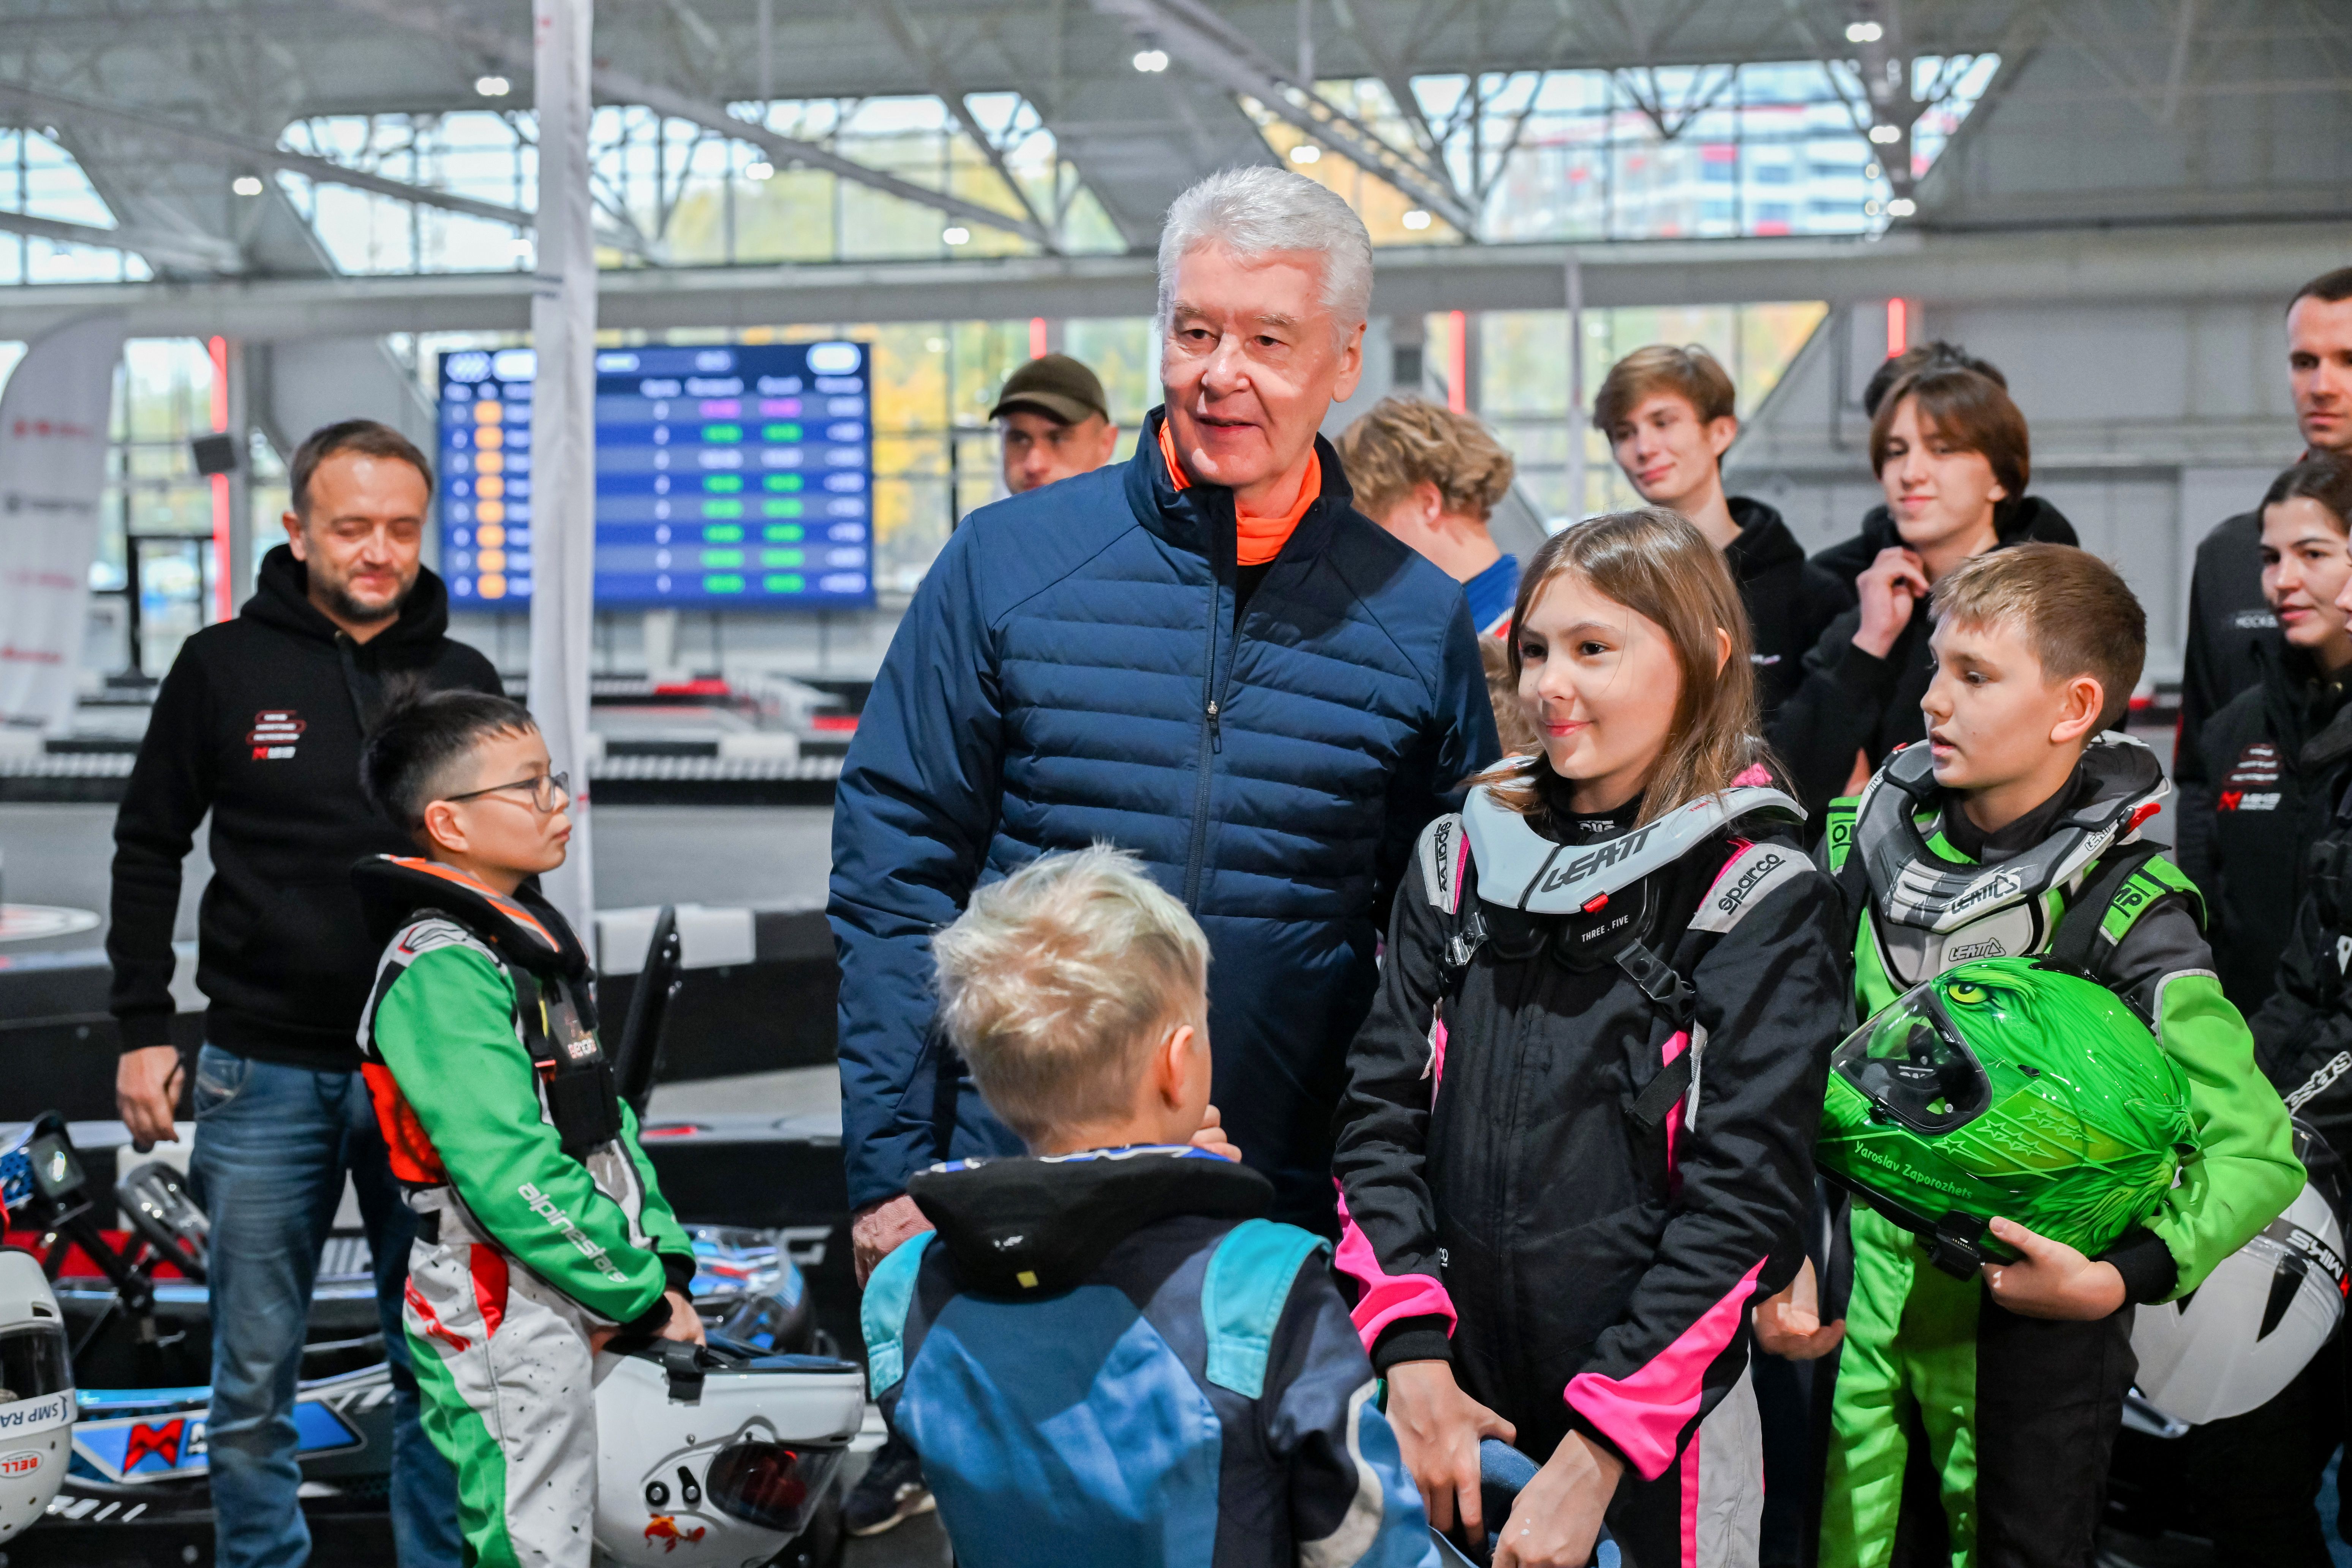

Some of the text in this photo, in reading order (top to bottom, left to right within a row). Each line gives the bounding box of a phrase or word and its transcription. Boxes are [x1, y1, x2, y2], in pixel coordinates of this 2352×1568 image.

[1541, 822, 1661, 893] LEATT
[1718, 854, 1783, 913] sparco
[1952, 882, 1995, 914] LEATT
[1581, 925, 1605, 942] THREE
[1612, 915, 1629, 929] FIVE
[1949, 941, 1991, 962] LEATT
[1855, 1141, 1973, 1199] Yaroslav Zaporozhets
[518, 1182, 629, 1283] alpinestars
[2285, 1229, 2344, 1280] MIKS
[28, 1403, 58, 1422] SMP
[2, 1456, 38, 1473] BELL
